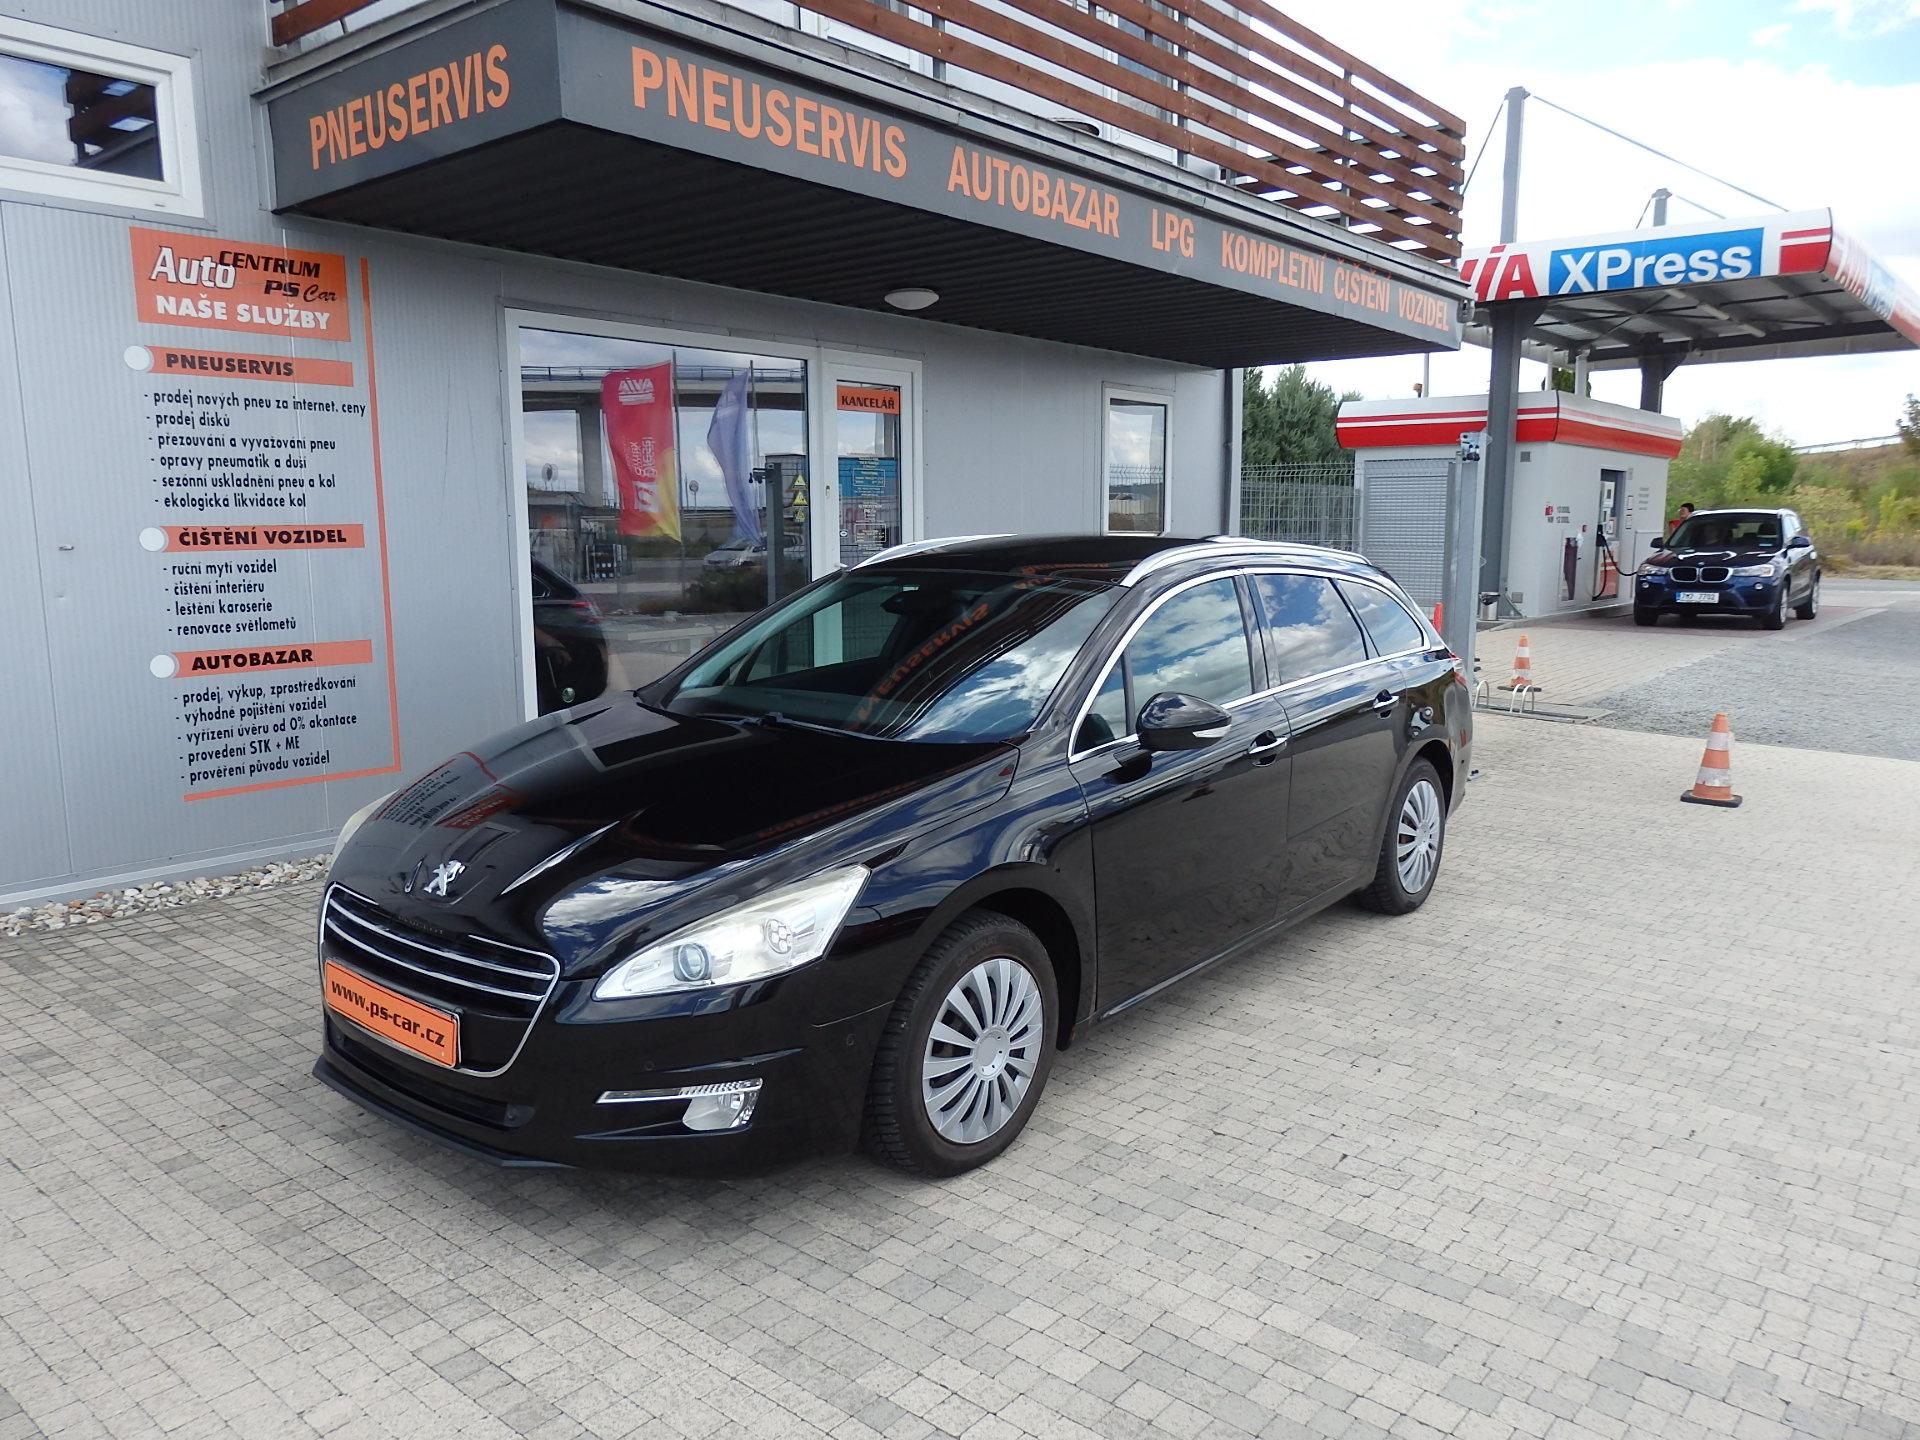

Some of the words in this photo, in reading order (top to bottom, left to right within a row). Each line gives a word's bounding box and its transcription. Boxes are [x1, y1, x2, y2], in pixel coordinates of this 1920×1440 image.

[309, 44, 511, 171] PNEUSERVIS
[631, 46, 907, 178] PNEUSERVIS
[947, 145, 1120, 238] AUTOBAZAR
[1151, 208, 1196, 258] LPG
[1221, 230, 1327, 294] KOMPLETNÍ
[1332, 258, 1392, 313] ČIŠTĚNÍ
[1398, 290, 1450, 331] VOZIDEL
[150, 245, 236, 289] Auto
[219, 251, 321, 278] CENTRUM
[1558, 245, 1752, 294] XPress
[264, 280, 301, 297] PS
[303, 284, 337, 302] Car
[156, 293, 228, 321] NAŠE
[236, 303, 331, 330] SLUŽBY
[166, 353, 294, 376] PNEUSERVIS
[154, 389, 193, 408] prodej
[197, 391, 239, 409] nových
[244, 397, 271, 410] pneu
[275, 399, 288, 409] za
[293, 395, 338, 412] internet.
[341, 403, 366, 417] ceny
[841, 394, 895, 411] KANCELÁŘ
[156, 410, 195, 429] prodej
[199, 411, 230, 427] disků
[158, 432, 225, 449] přezouvání
[229, 437, 237, 447] a
[241, 436, 306, 451] vyvažování
[310, 440, 336, 453] pneu
[160, 456, 203, 470] opravy
[208, 453, 269, 470] pneumatik
[274, 459, 281, 468] a
[286, 453, 307, 468] duší
[162, 474, 207, 487] sezónní
[211, 473, 274, 487] uskladnění
[278, 478, 305, 491] pneu
[308, 479, 315, 488] a
[318, 474, 336, 488] kol
[164, 492, 229, 511] ekologická
[234, 492, 285, 507] likvidace
[289, 493, 306, 507] kol
[179, 527, 257, 546] ČIŠTĚNÍ
[264, 529, 347, 544] VOZIDEL
[172, 562, 202, 575] ruční
[205, 561, 233, 577] mytí
[236, 558, 277, 574] vozidel
[174, 581, 212, 595] čištění
[216, 579, 265, 594] interiéru
[175, 601, 215, 615] leštění
[219, 598, 273, 614] karoserie
[177, 621, 232, 636] renovace
[236, 617, 297, 632] světlometů
[191, 649, 314, 671] AUTOBAZAR
[227, 684, 266, 702] výkup,
[270, 675, 356, 698] zprostředkování
[185, 706, 235, 726] výhodné
[240, 701, 285, 721] pojištění
[289, 695, 327, 712] vozidel
[186, 725, 234, 746] vyřízení
[238, 723, 269, 736] úvěru
[273, 718, 286, 732] od
[290, 716, 305, 730] 0%
[309, 714, 357, 729] akontace
[188, 743, 246, 766] provedení
[249, 738, 272, 754] STK
[285, 736, 300, 750] ME
[190, 762, 246, 785] prověření
[249, 755, 289, 777] původu
[292, 750, 330, 767] vozidel
[331, 981, 445, 1048] www.ps-car.cz
